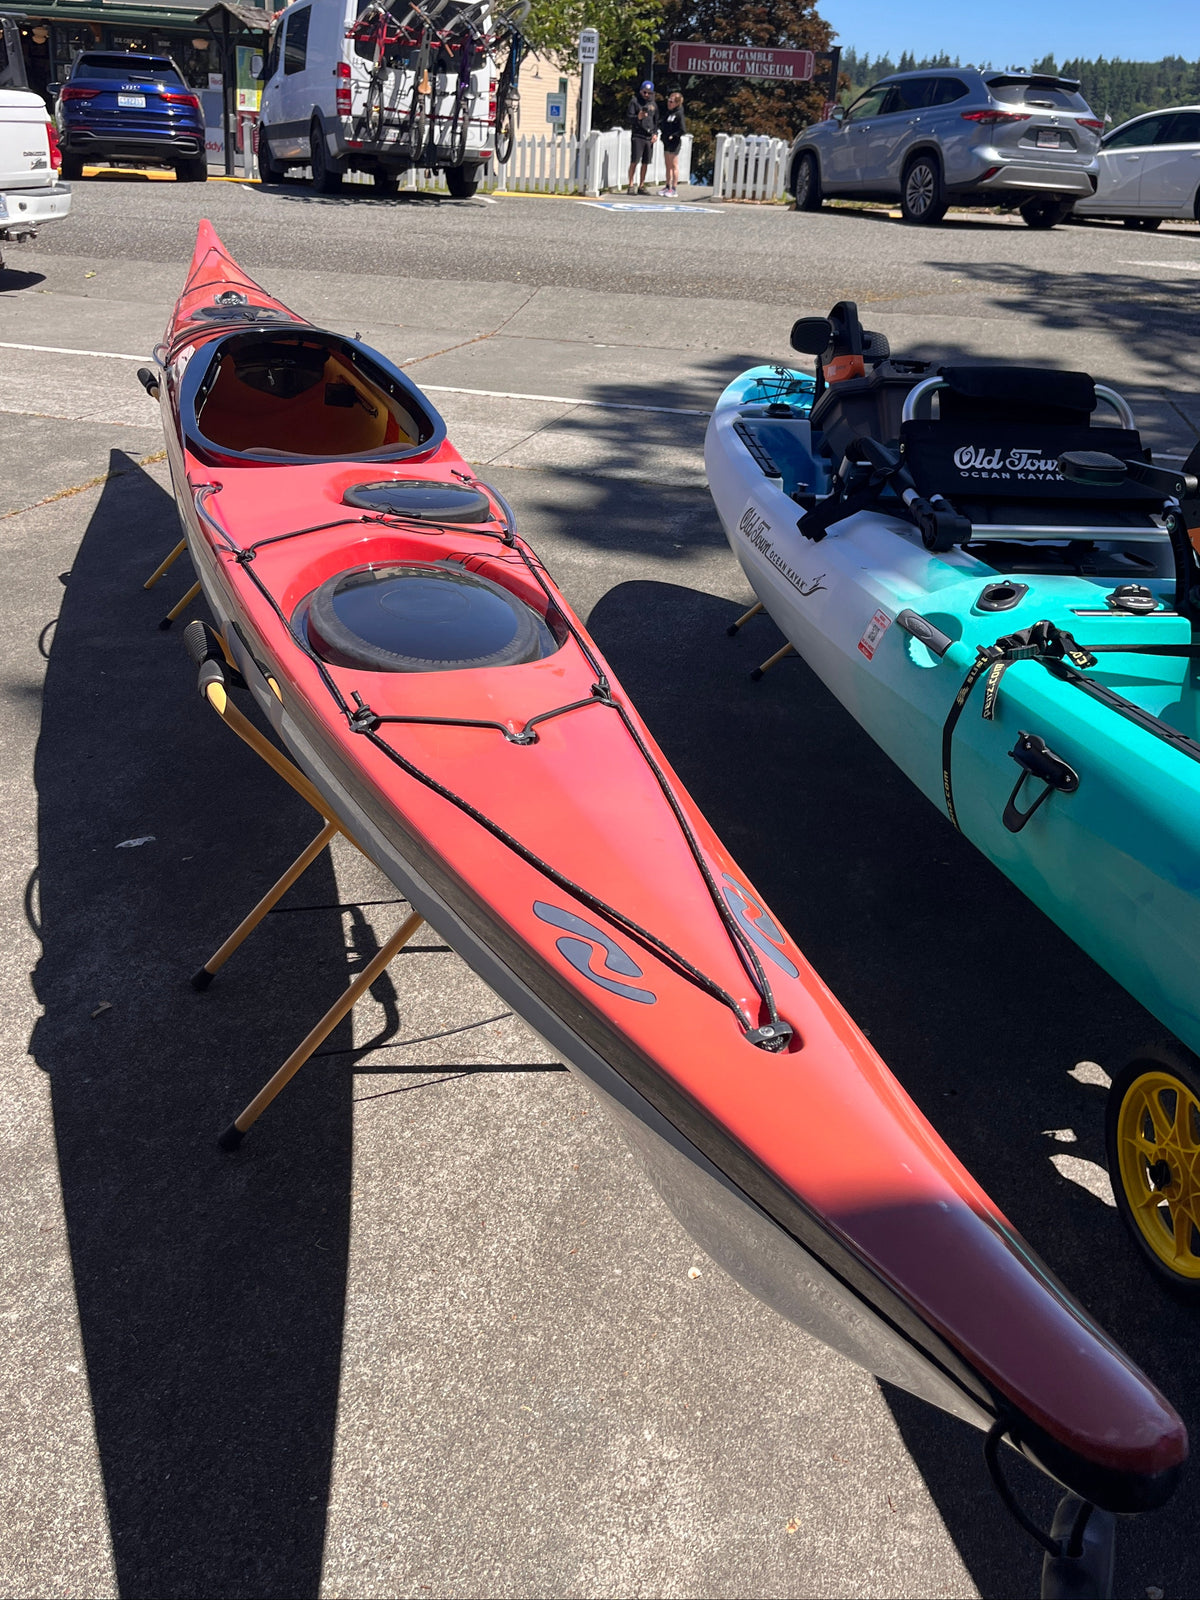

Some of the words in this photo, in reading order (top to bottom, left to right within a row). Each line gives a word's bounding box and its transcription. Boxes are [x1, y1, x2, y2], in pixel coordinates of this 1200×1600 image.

[583, 35, 595, 43] ONE
[582, 46, 595, 54] WAY
[709, 47, 733, 60] PORT
[736, 49, 774, 62] GAMBLE
[687, 57, 741, 73] HISTORIC
[744, 61, 794, 77] MUSEUM
[953, 445, 1003, 470] Old
[1005, 448, 1059, 471] Tow
[960, 471, 1010, 479] OCEAN
[1017, 472, 1065, 481] KAYAK
[740, 507, 760, 538] Old
[750, 520, 772, 555] Town
[769, 550, 787, 572] OCEAN
[786, 567, 806, 590] KAYAK
